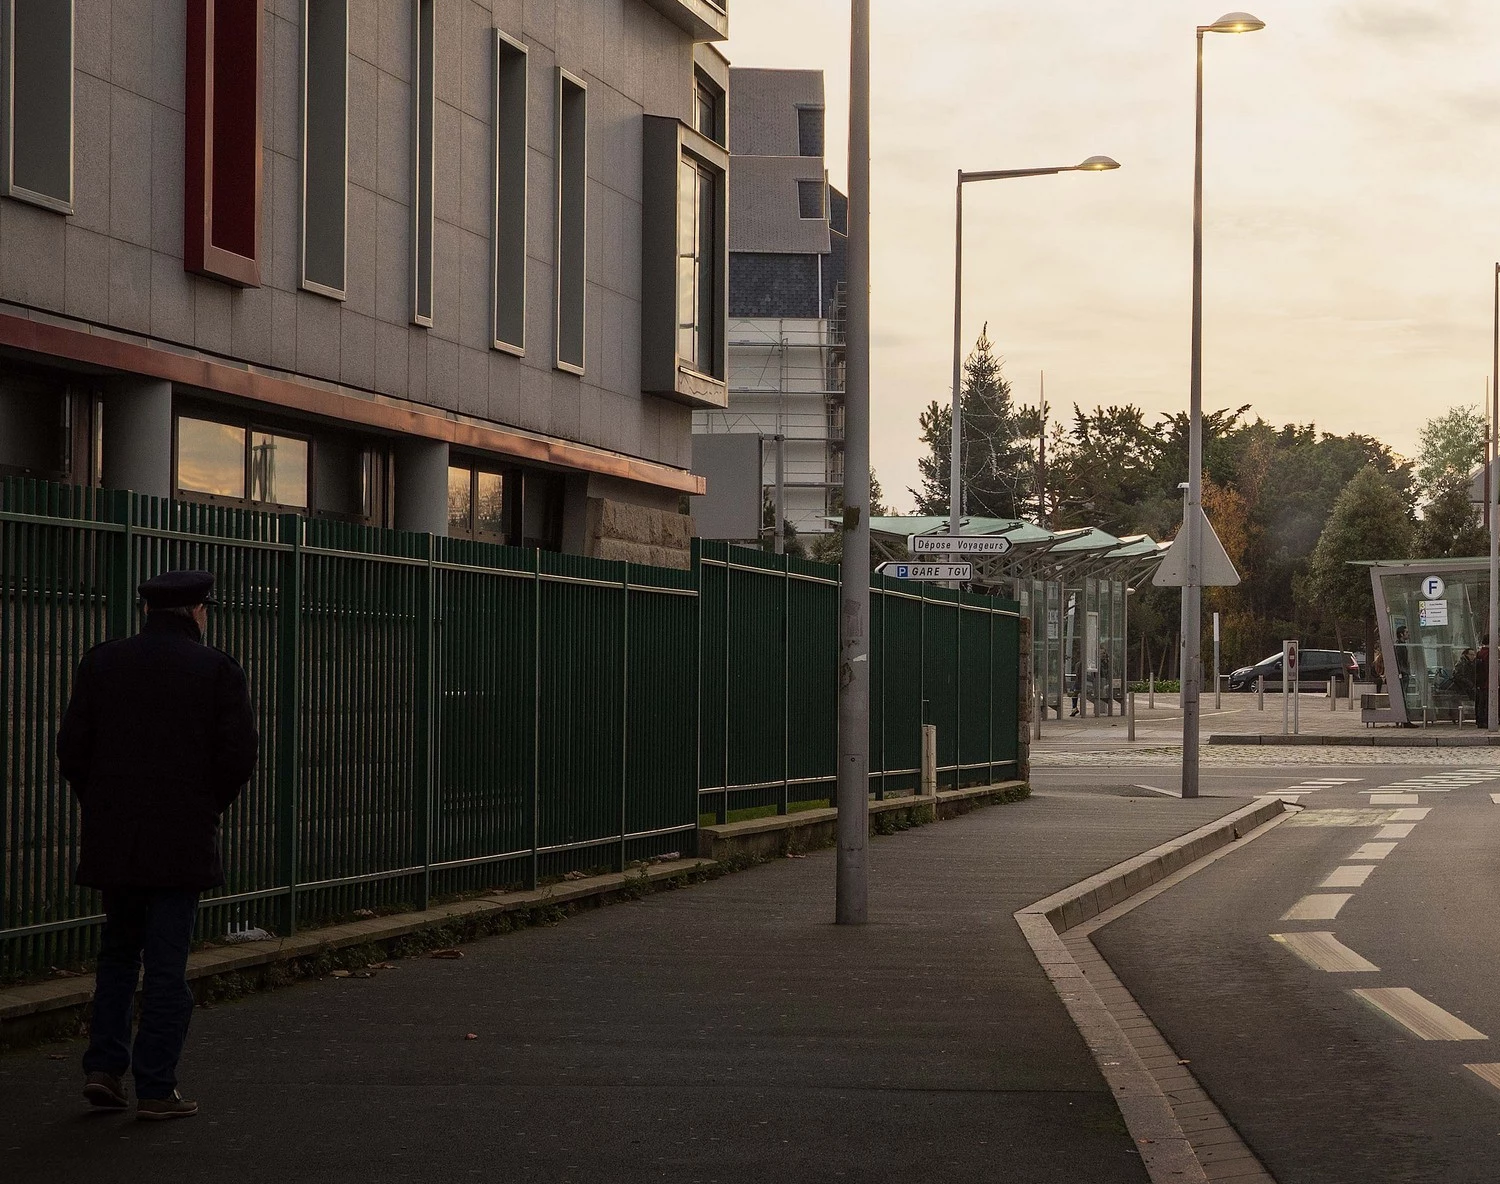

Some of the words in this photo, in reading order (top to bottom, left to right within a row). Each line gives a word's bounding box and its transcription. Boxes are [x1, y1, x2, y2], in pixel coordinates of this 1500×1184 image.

[918, 539, 951, 551] Dépose
[958, 540, 1003, 552] Voyageurs
[899, 567, 906, 576] P
[912, 567, 940, 576] GARE
[948, 567, 968, 576] TGV
[1429, 580, 1438, 594] F
